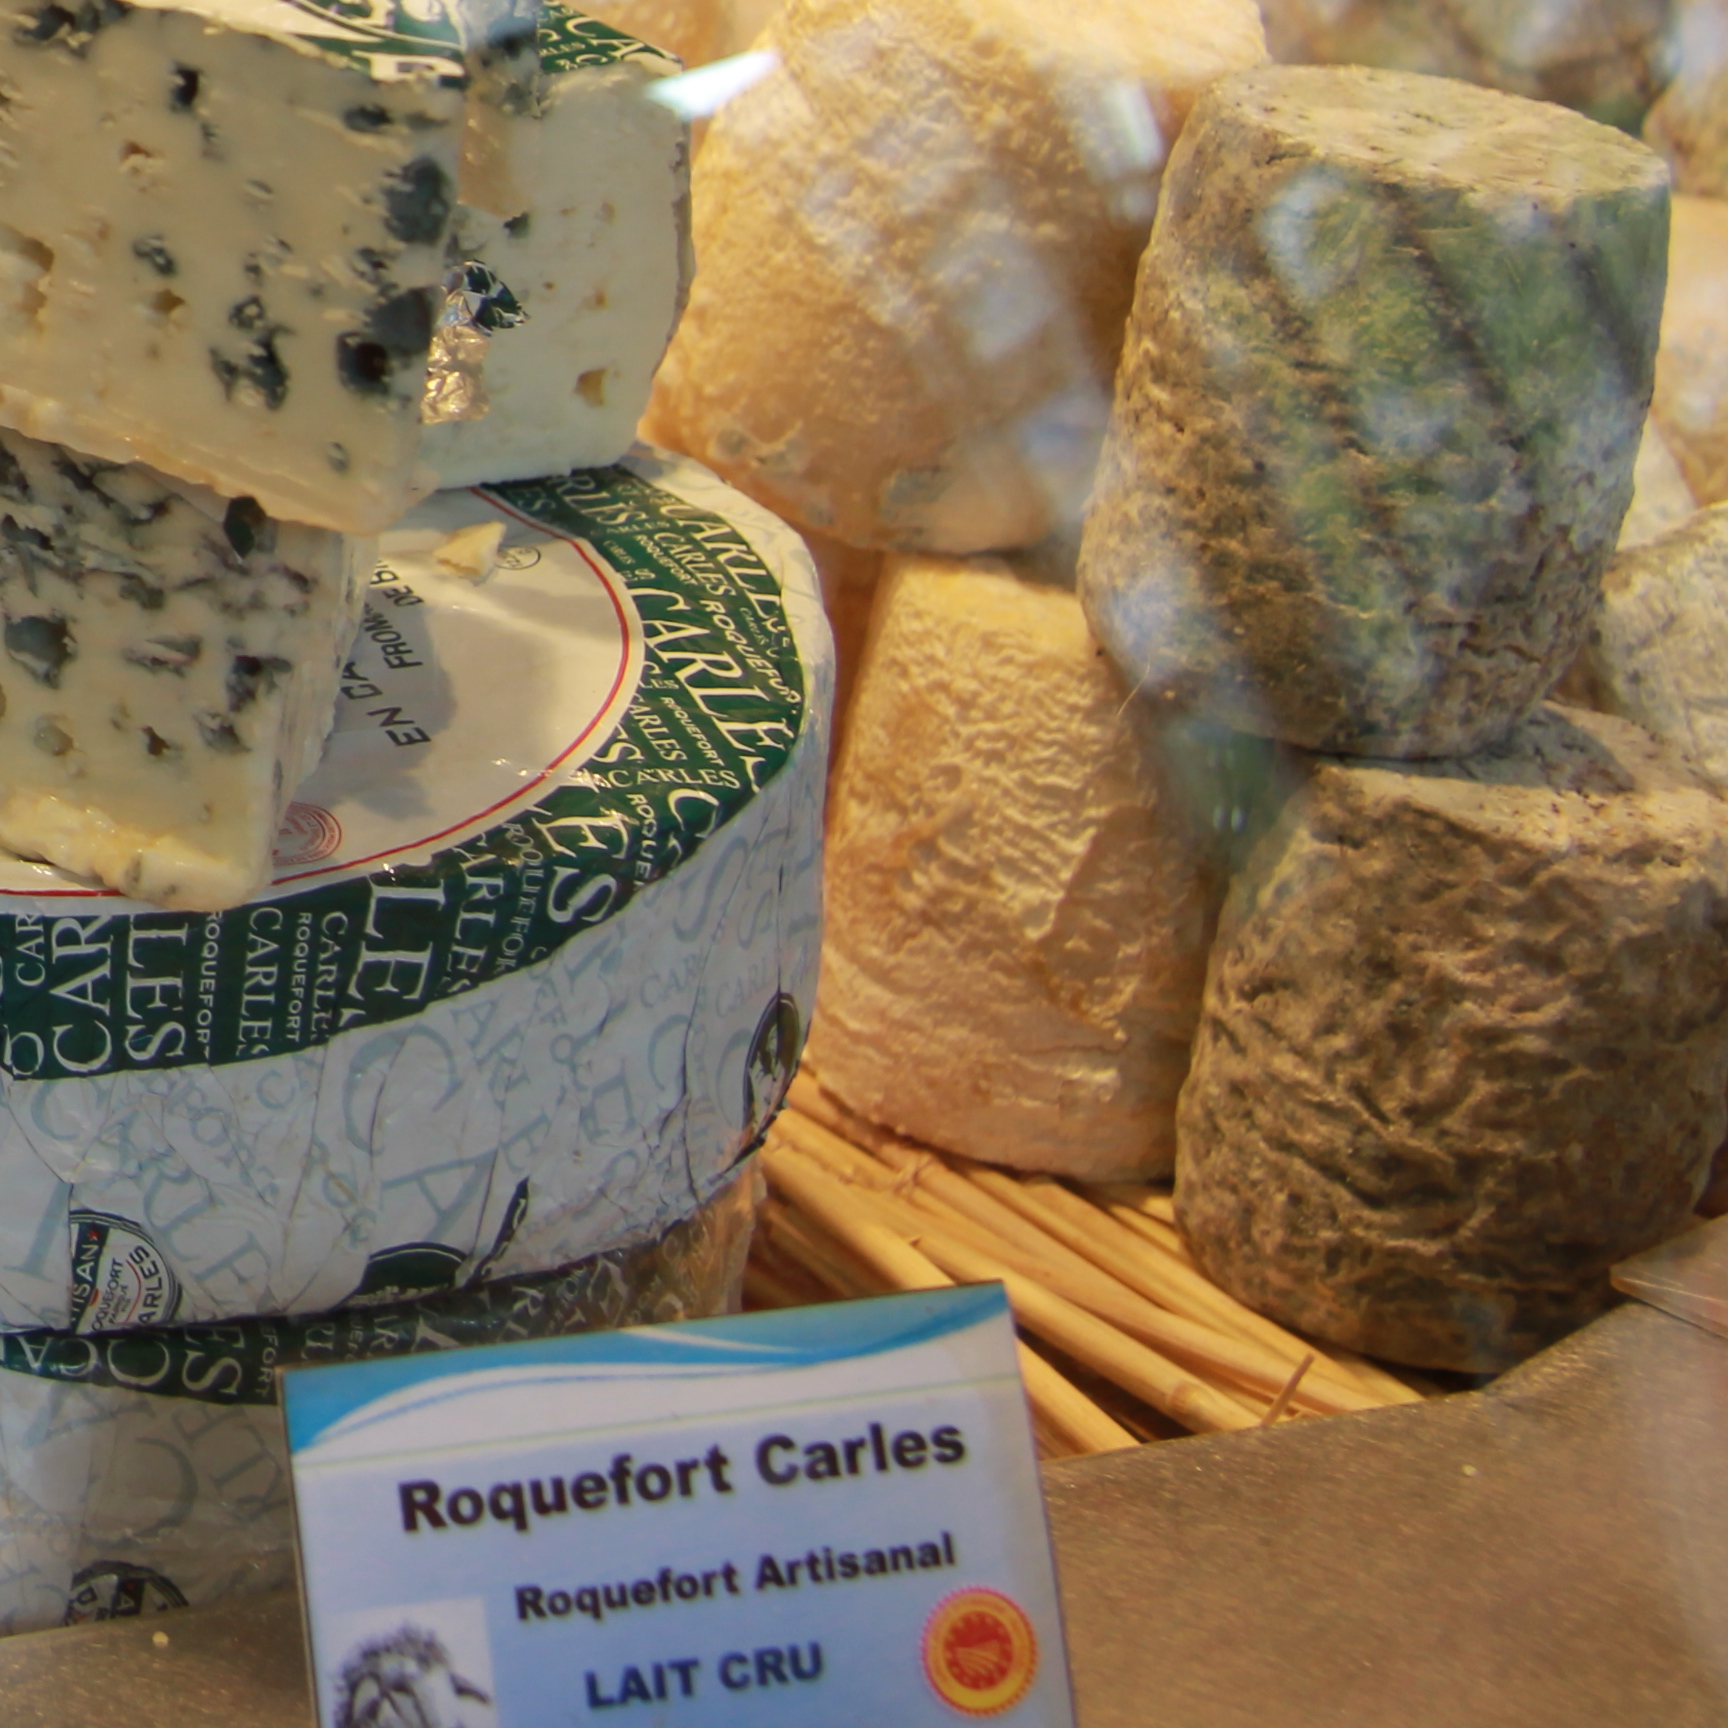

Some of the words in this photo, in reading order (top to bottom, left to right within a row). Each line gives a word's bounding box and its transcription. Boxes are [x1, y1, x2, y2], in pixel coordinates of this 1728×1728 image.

[635, 533, 698, 586] ROQUEFORT
[653, 531, 738, 598] CARLES
[366, 706, 432, 747] EN
[661, 695, 726, 767] ROQUEFORT
[607, 767, 742, 791] CARLES
[285, 912, 313, 1043] ROQUEFORT
[397, 1444, 732, 1536] Roquefort
[753, 1420, 969, 1490] Carles
[512, 1566, 741, 1624] Roquefort
[754, 1531, 958, 1593] Artisanal
[584, 1658, 701, 1711] LAIT
[718, 1641, 825, 1694] CRU
